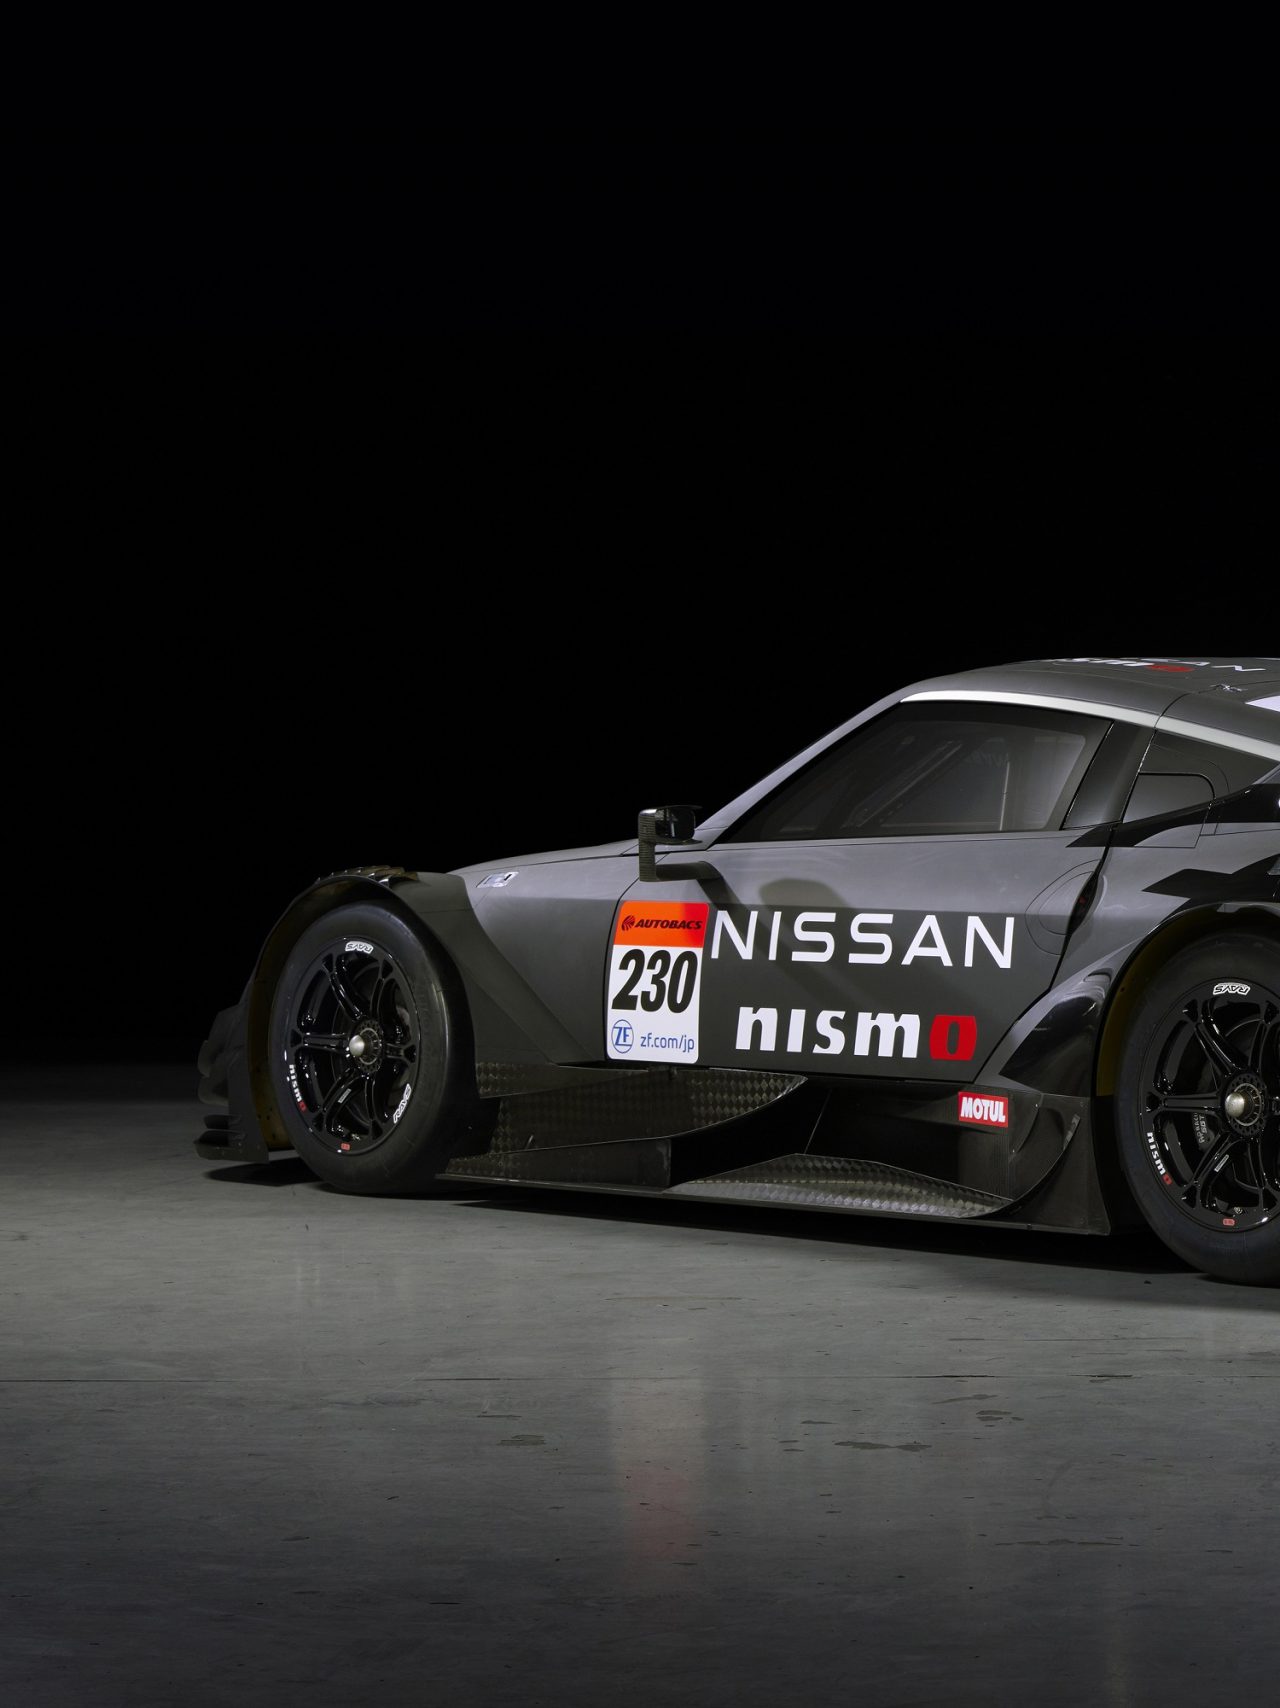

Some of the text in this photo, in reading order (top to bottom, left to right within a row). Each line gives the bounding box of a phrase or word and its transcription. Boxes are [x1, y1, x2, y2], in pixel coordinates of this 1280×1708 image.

[634, 918, 703, 930] AUTOBACS
[710, 910, 1015, 969] NISSAN
[345, 940, 374, 954] RAYS
[611, 948, 698, 1014] 230
[1213, 982, 1251, 996] RAYS
[613, 1025, 633, 1047] ZF
[640, 1032, 695, 1053] zf.com/jp
[735, 1006, 978, 1061] nismo
[289, 1064, 307, 1112] nismo
[393, 1083, 412, 1124] RAYS
[960, 1096, 1006, 1123] MOTUL
[1147, 1132, 1173, 1185] nismo
